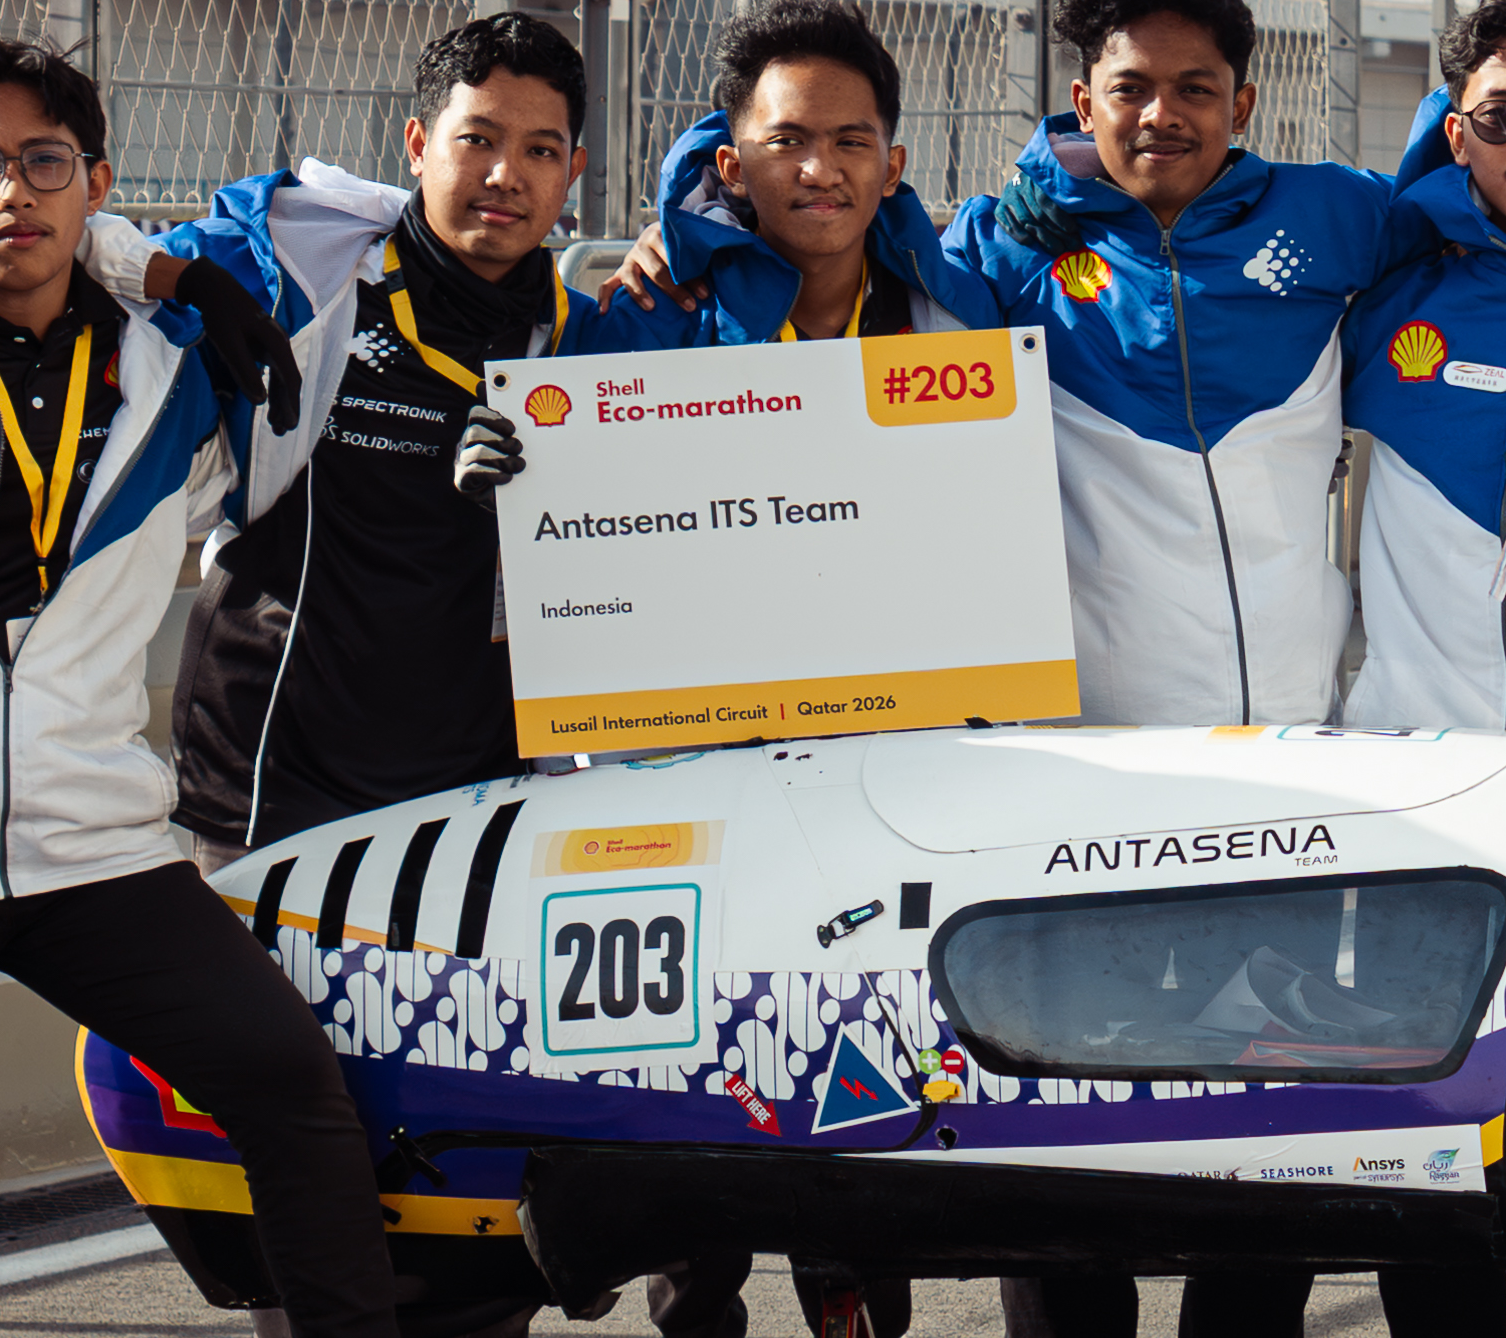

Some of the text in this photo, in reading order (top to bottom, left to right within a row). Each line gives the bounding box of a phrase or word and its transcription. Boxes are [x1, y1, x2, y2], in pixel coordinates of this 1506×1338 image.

[596, 378, 646, 398] Shell
[883, 362, 995, 404] #203
[341, 396, 447, 423] SPECTRONIK
[597, 390, 803, 424] Eco-marathon
[341, 430, 440, 457] SOLIDWORKS
[534, 495, 860, 542] Antasena ITS Team
[540, 597, 633, 619] Indonesia
[551, 694, 897, 735] Lusail International Circuit Qatar 2026
[606, 841, 672, 853] Eco-marathon
[607, 838, 624, 846] Shell
[1044, 824, 1336, 874] ANTASENA
[1295, 855, 1338, 867] TEAM
[554, 915, 686, 1022] 203
[731, 1081, 772, 1125] LIFT HERE
[1260, 1165, 1334, 1180] SEASHORE
[1353, 1157, 1405, 1171] Ansys
